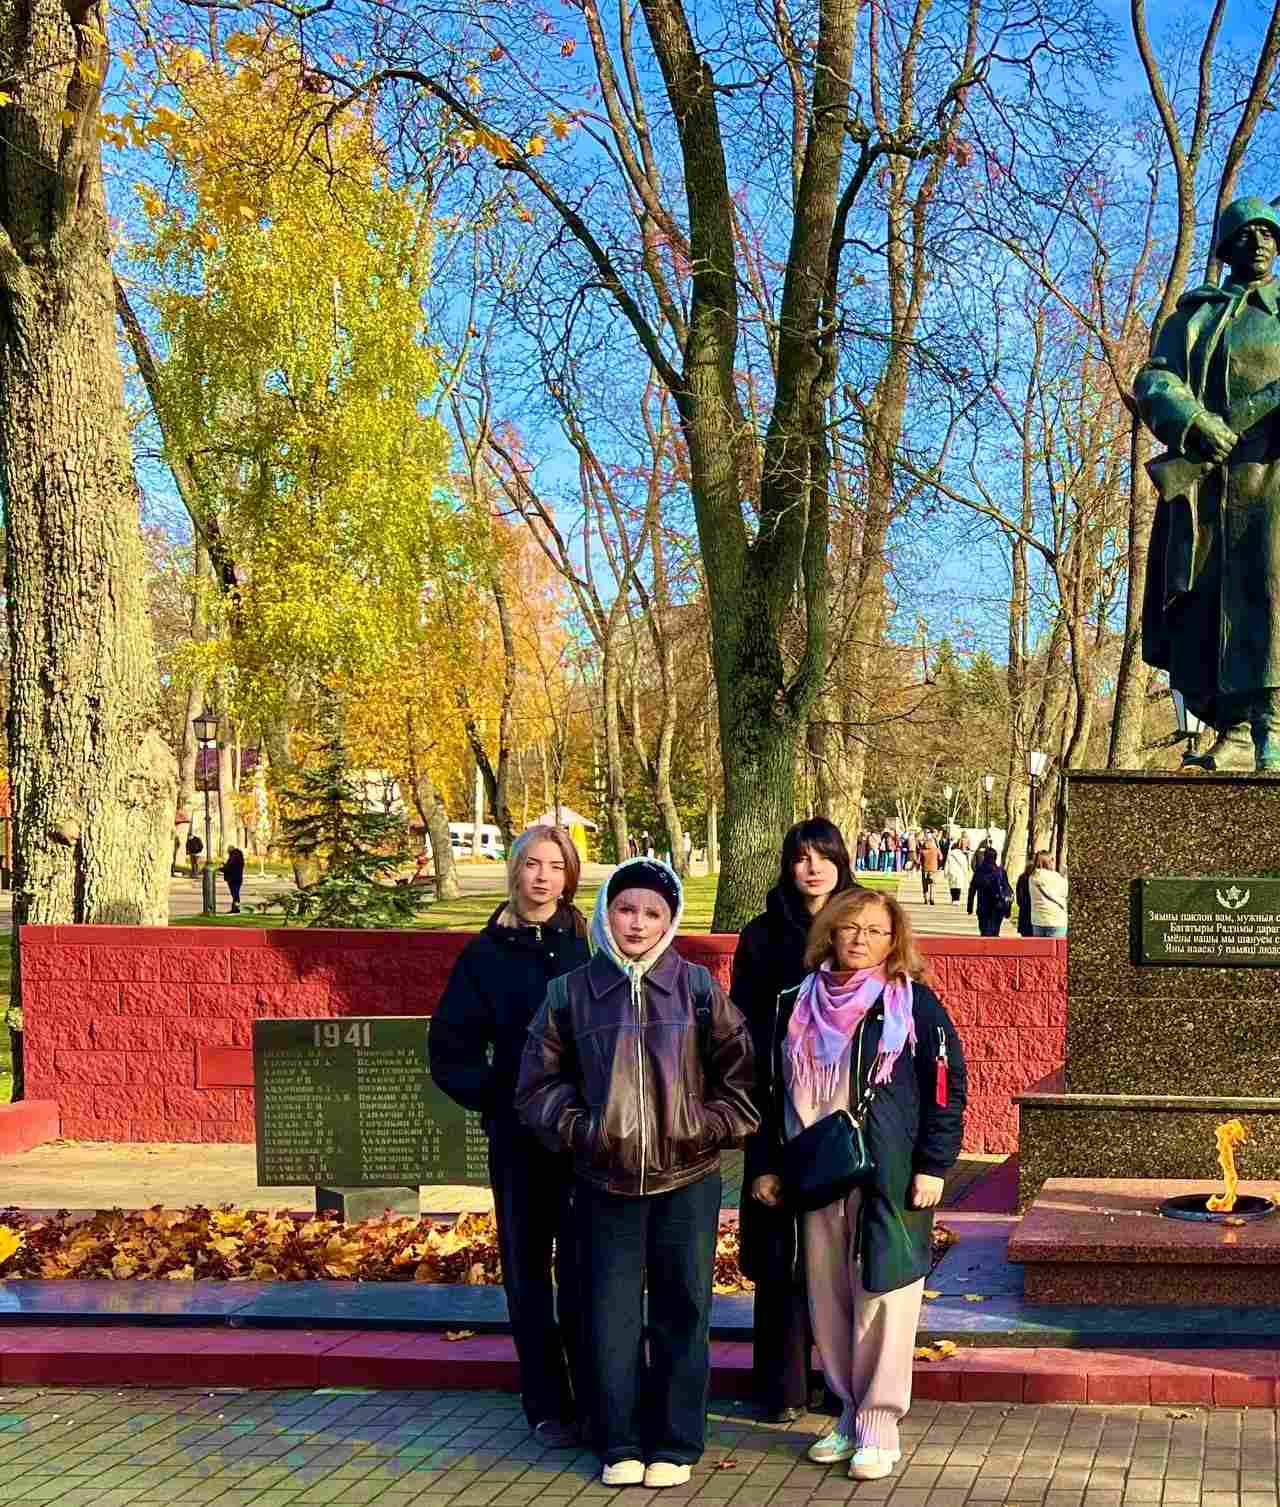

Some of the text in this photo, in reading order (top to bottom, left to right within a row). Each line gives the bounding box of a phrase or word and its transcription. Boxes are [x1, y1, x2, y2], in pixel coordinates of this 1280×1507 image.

[1237, 914, 1274, 925] мужныя
[1221, 935, 1235, 943] мы
[313, 1023, 371, 1047] 1941
